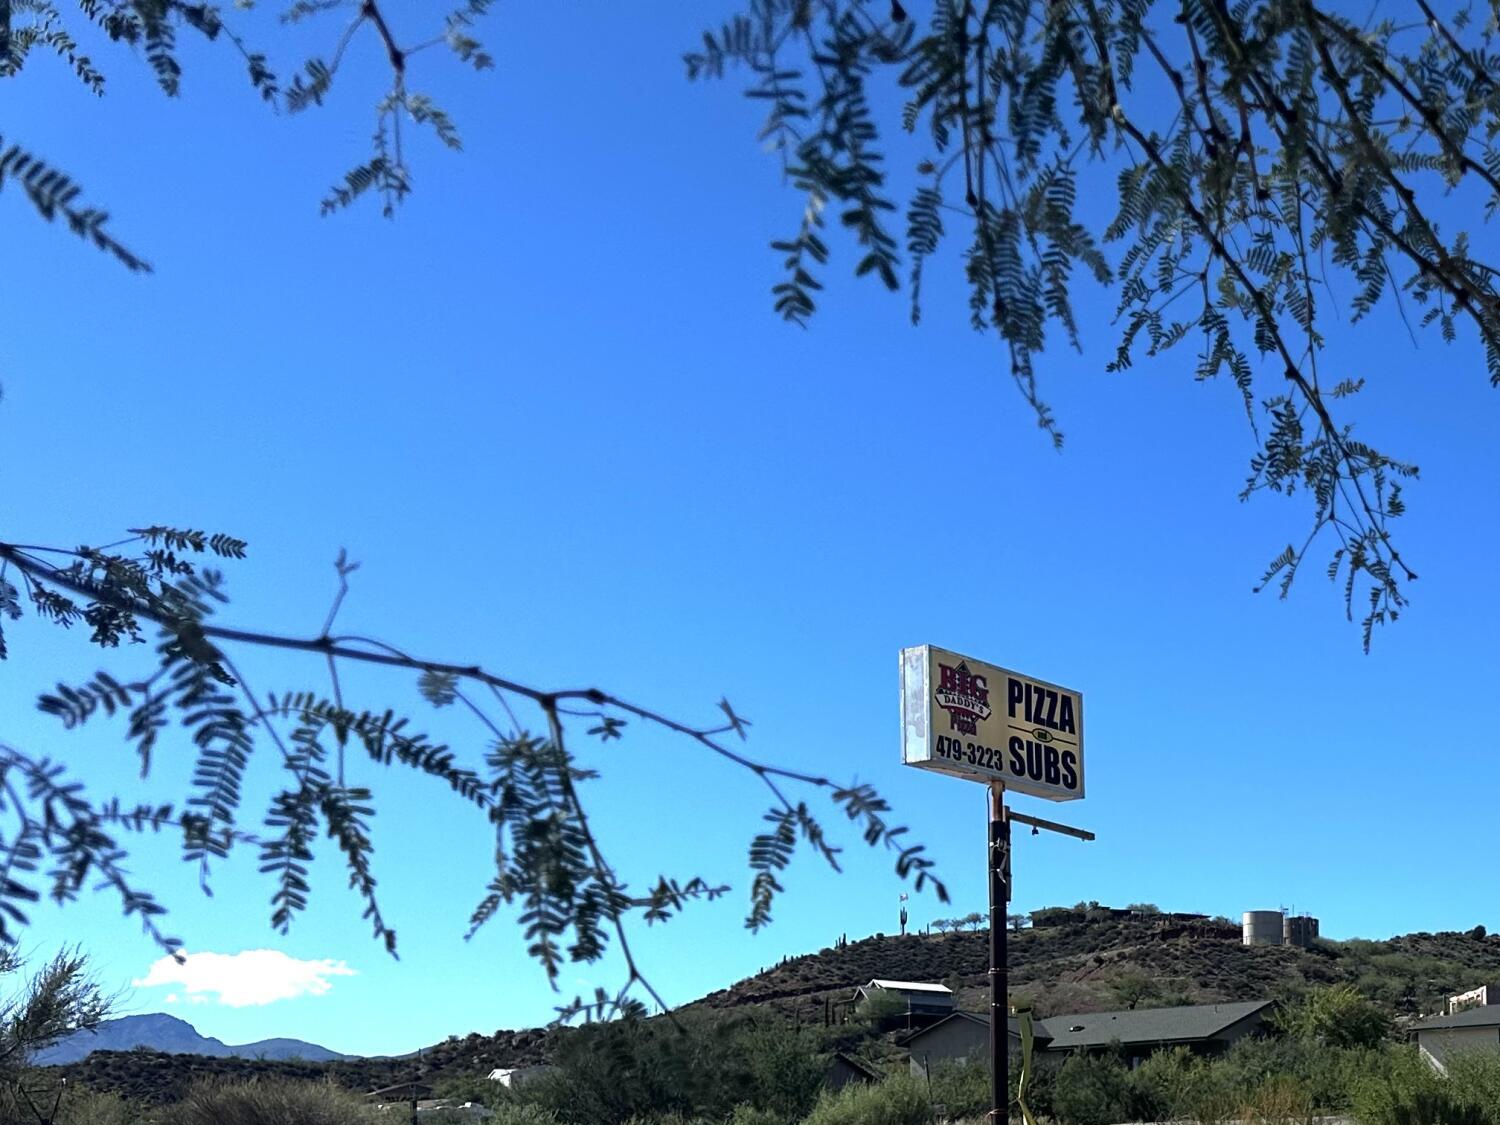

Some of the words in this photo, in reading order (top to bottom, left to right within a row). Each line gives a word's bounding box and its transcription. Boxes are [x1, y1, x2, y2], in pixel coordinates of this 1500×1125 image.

[939, 663, 989, 704] BIG
[944, 695, 984, 713] DADDY'S
[1008, 677, 1076, 735] PIZZA
[936, 735, 1003, 771] 479-3223
[1009, 736, 1077, 790] SUBS
